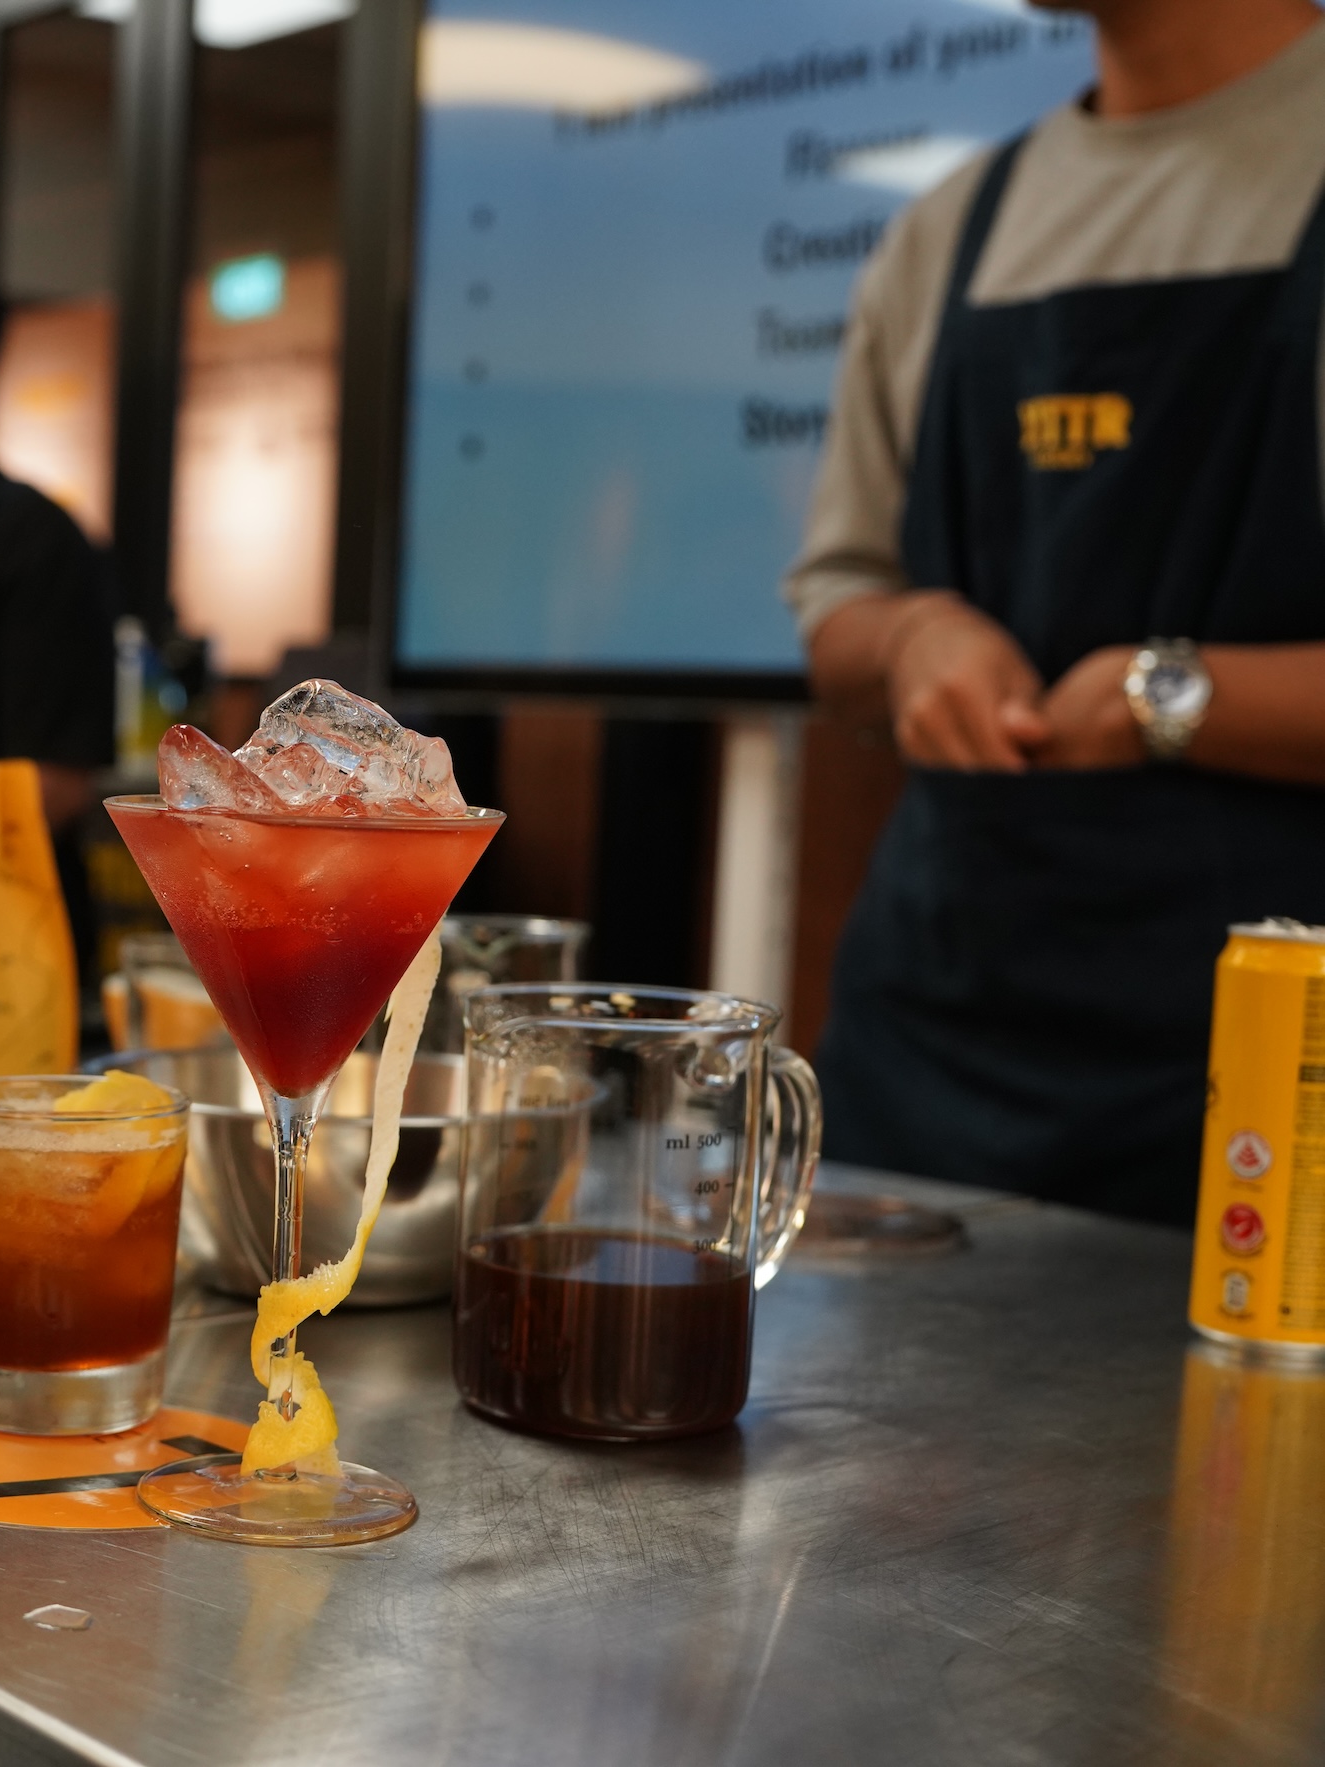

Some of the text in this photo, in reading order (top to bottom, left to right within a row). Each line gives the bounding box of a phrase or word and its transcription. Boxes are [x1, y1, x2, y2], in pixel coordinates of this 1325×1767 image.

[666, 1132, 722, 1149] ml 500
[694, 1179, 720, 1196] 400
